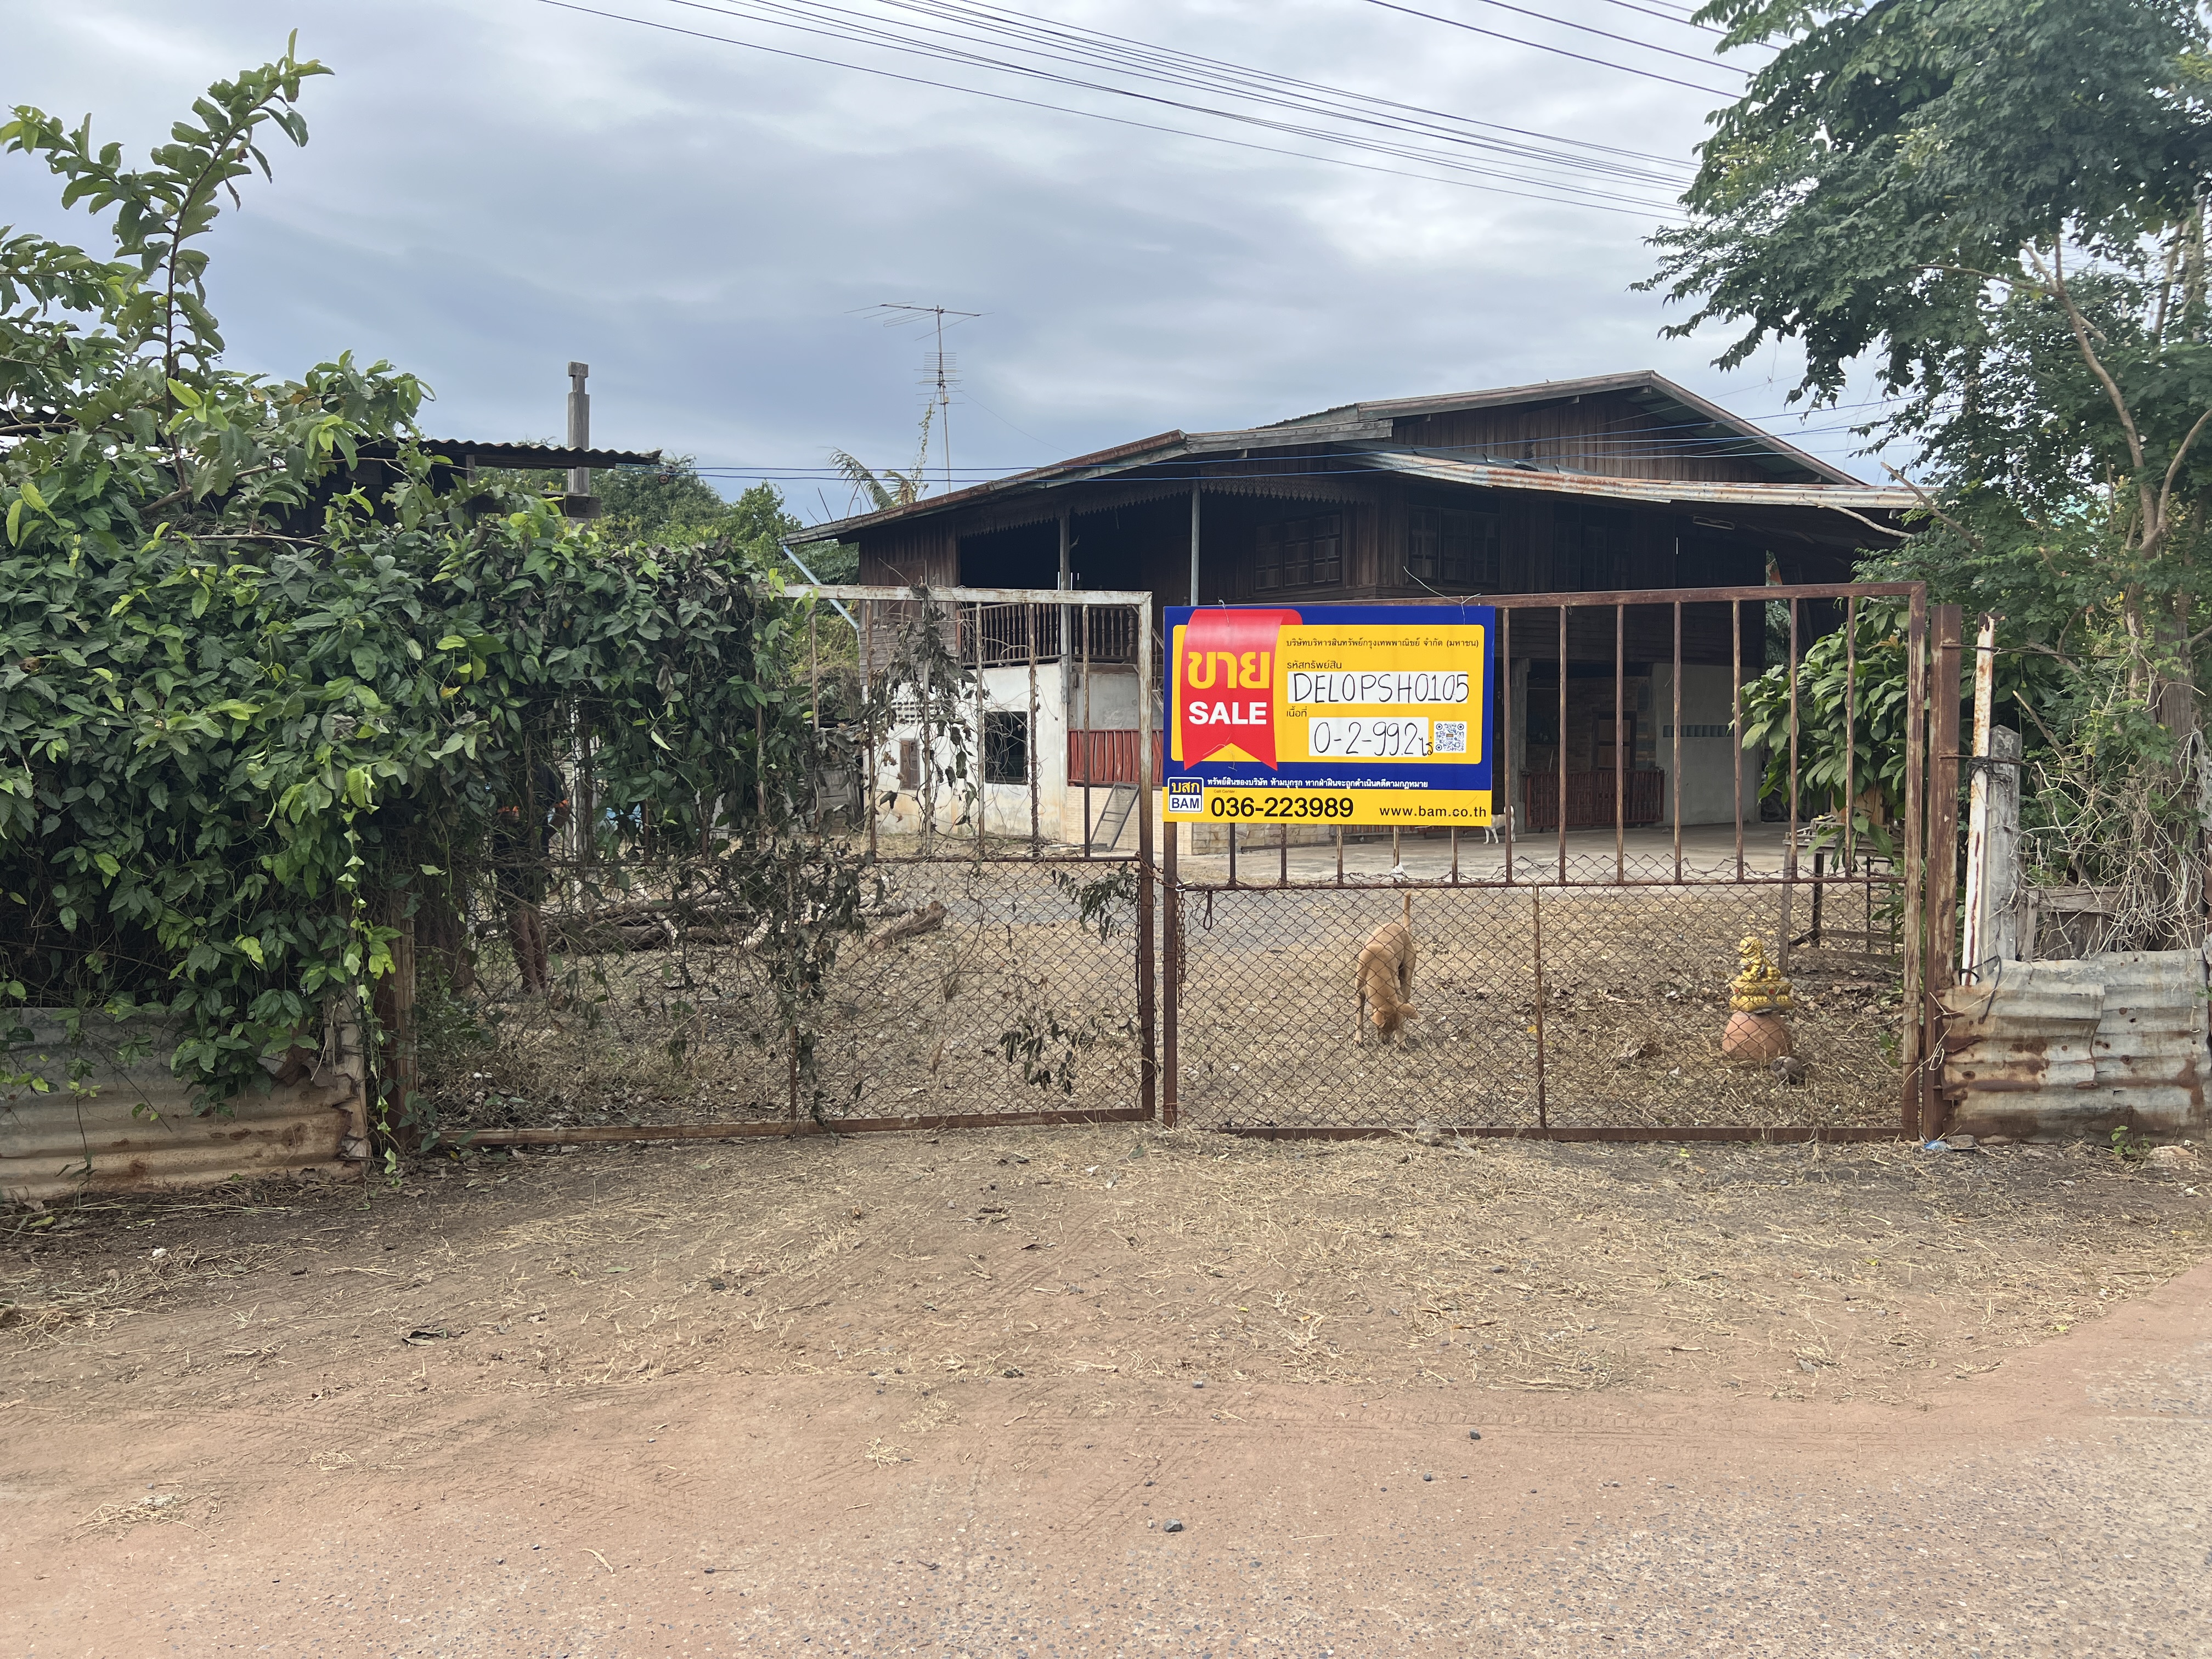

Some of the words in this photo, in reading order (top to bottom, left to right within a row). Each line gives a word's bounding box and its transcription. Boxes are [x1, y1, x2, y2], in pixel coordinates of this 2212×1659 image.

[1423, 638, 1443, 647] จำกัด
[1188, 651, 1271, 689] ขาย
[1286, 660, 1342, 669] รหัสทรัพย์สิน
[1188, 701, 1267, 725] SALE
[1286, 706, 1307, 718] เนื้อที่
[1171, 781, 1200, 793] บสก
[1271, 777, 1302, 788] ห้ามบุกรุก
[1171, 798, 1199, 809] BAM
[1211, 797, 1353, 817] 036-223989
[1379, 805, 1486, 817] www.bam.co.th
